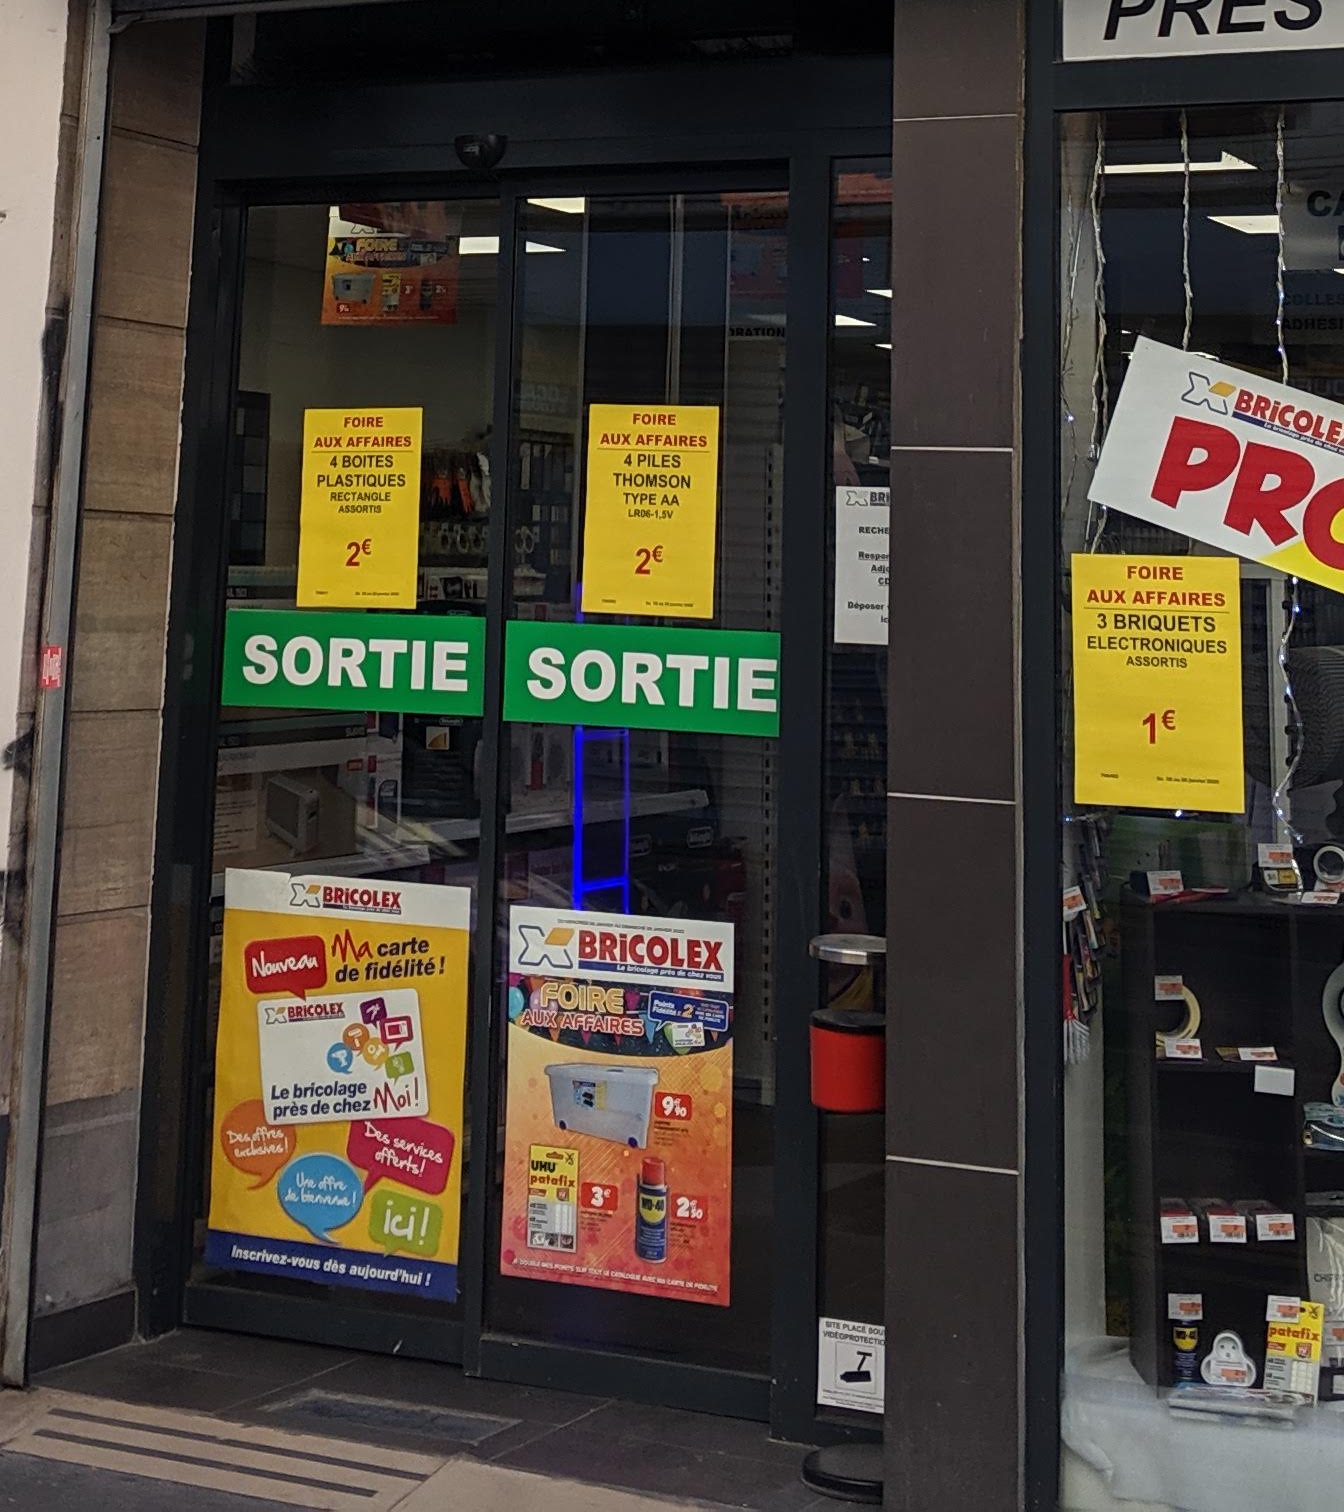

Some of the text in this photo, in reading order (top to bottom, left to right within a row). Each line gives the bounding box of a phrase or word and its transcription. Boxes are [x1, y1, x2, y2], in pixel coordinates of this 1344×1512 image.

[344, 417, 384, 428] FOIRE
[633, 414, 676, 426] FOIRE
[314, 436, 411, 448] AUX AFFAIRES
[600, 433, 707, 447] AUX AFFAIRES
[330, 455, 394, 468] 4 BOITES
[624, 454, 681, 468] 4 PILES
[317, 474, 406, 488] PLASTIQUES
[613, 473, 691, 488] THOMSON
[330, 492, 391, 502] RECTANGLE
[623, 493, 680, 506] TYPE AA
[338, 505, 382, 514] ASSORTIS
[346, 539, 372, 567] 2€
[635, 545, 664, 575] 2€
[1127, 566, 1184, 580] FOIRE
[1087, 590, 1225, 607] AUX AFFAIRES
[1097, 613, 1215, 633] 3 BRIQUETS
[1087, 636, 1227, 654] ELECTRONIQUES
[242, 634, 470, 693] SORTIE
[1126, 656, 1188, 669] ASSORTIS
[526, 647, 778, 713] SORTIE
[1142, 710, 1176, 745] 1€
[252, 929, 429, 978] Nouveau Ma carte
[578, 930, 724, 971] BRiCOLEX
[335, 965, 359, 983] de
[627, 964, 659, 975] bricolage
[541, 983, 625, 1015] FOIRE
[522, 1009, 645, 1037] AUX AFFAIRES
[271, 1081, 367, 1100] Le bricolage
[273, 1102, 307, 1120] près
[311, 1100, 330, 1115] de
[335, 1098, 371, 1112] chez
[364, 1121, 443, 1164] Des services
[531, 1160, 556, 1173] UHU
[530, 1174, 575, 1188] patafix
[231, 1244, 423, 1285] Inscrivez-vous dès aujourd'hui
[1269, 1327, 1320, 1342] patafix
